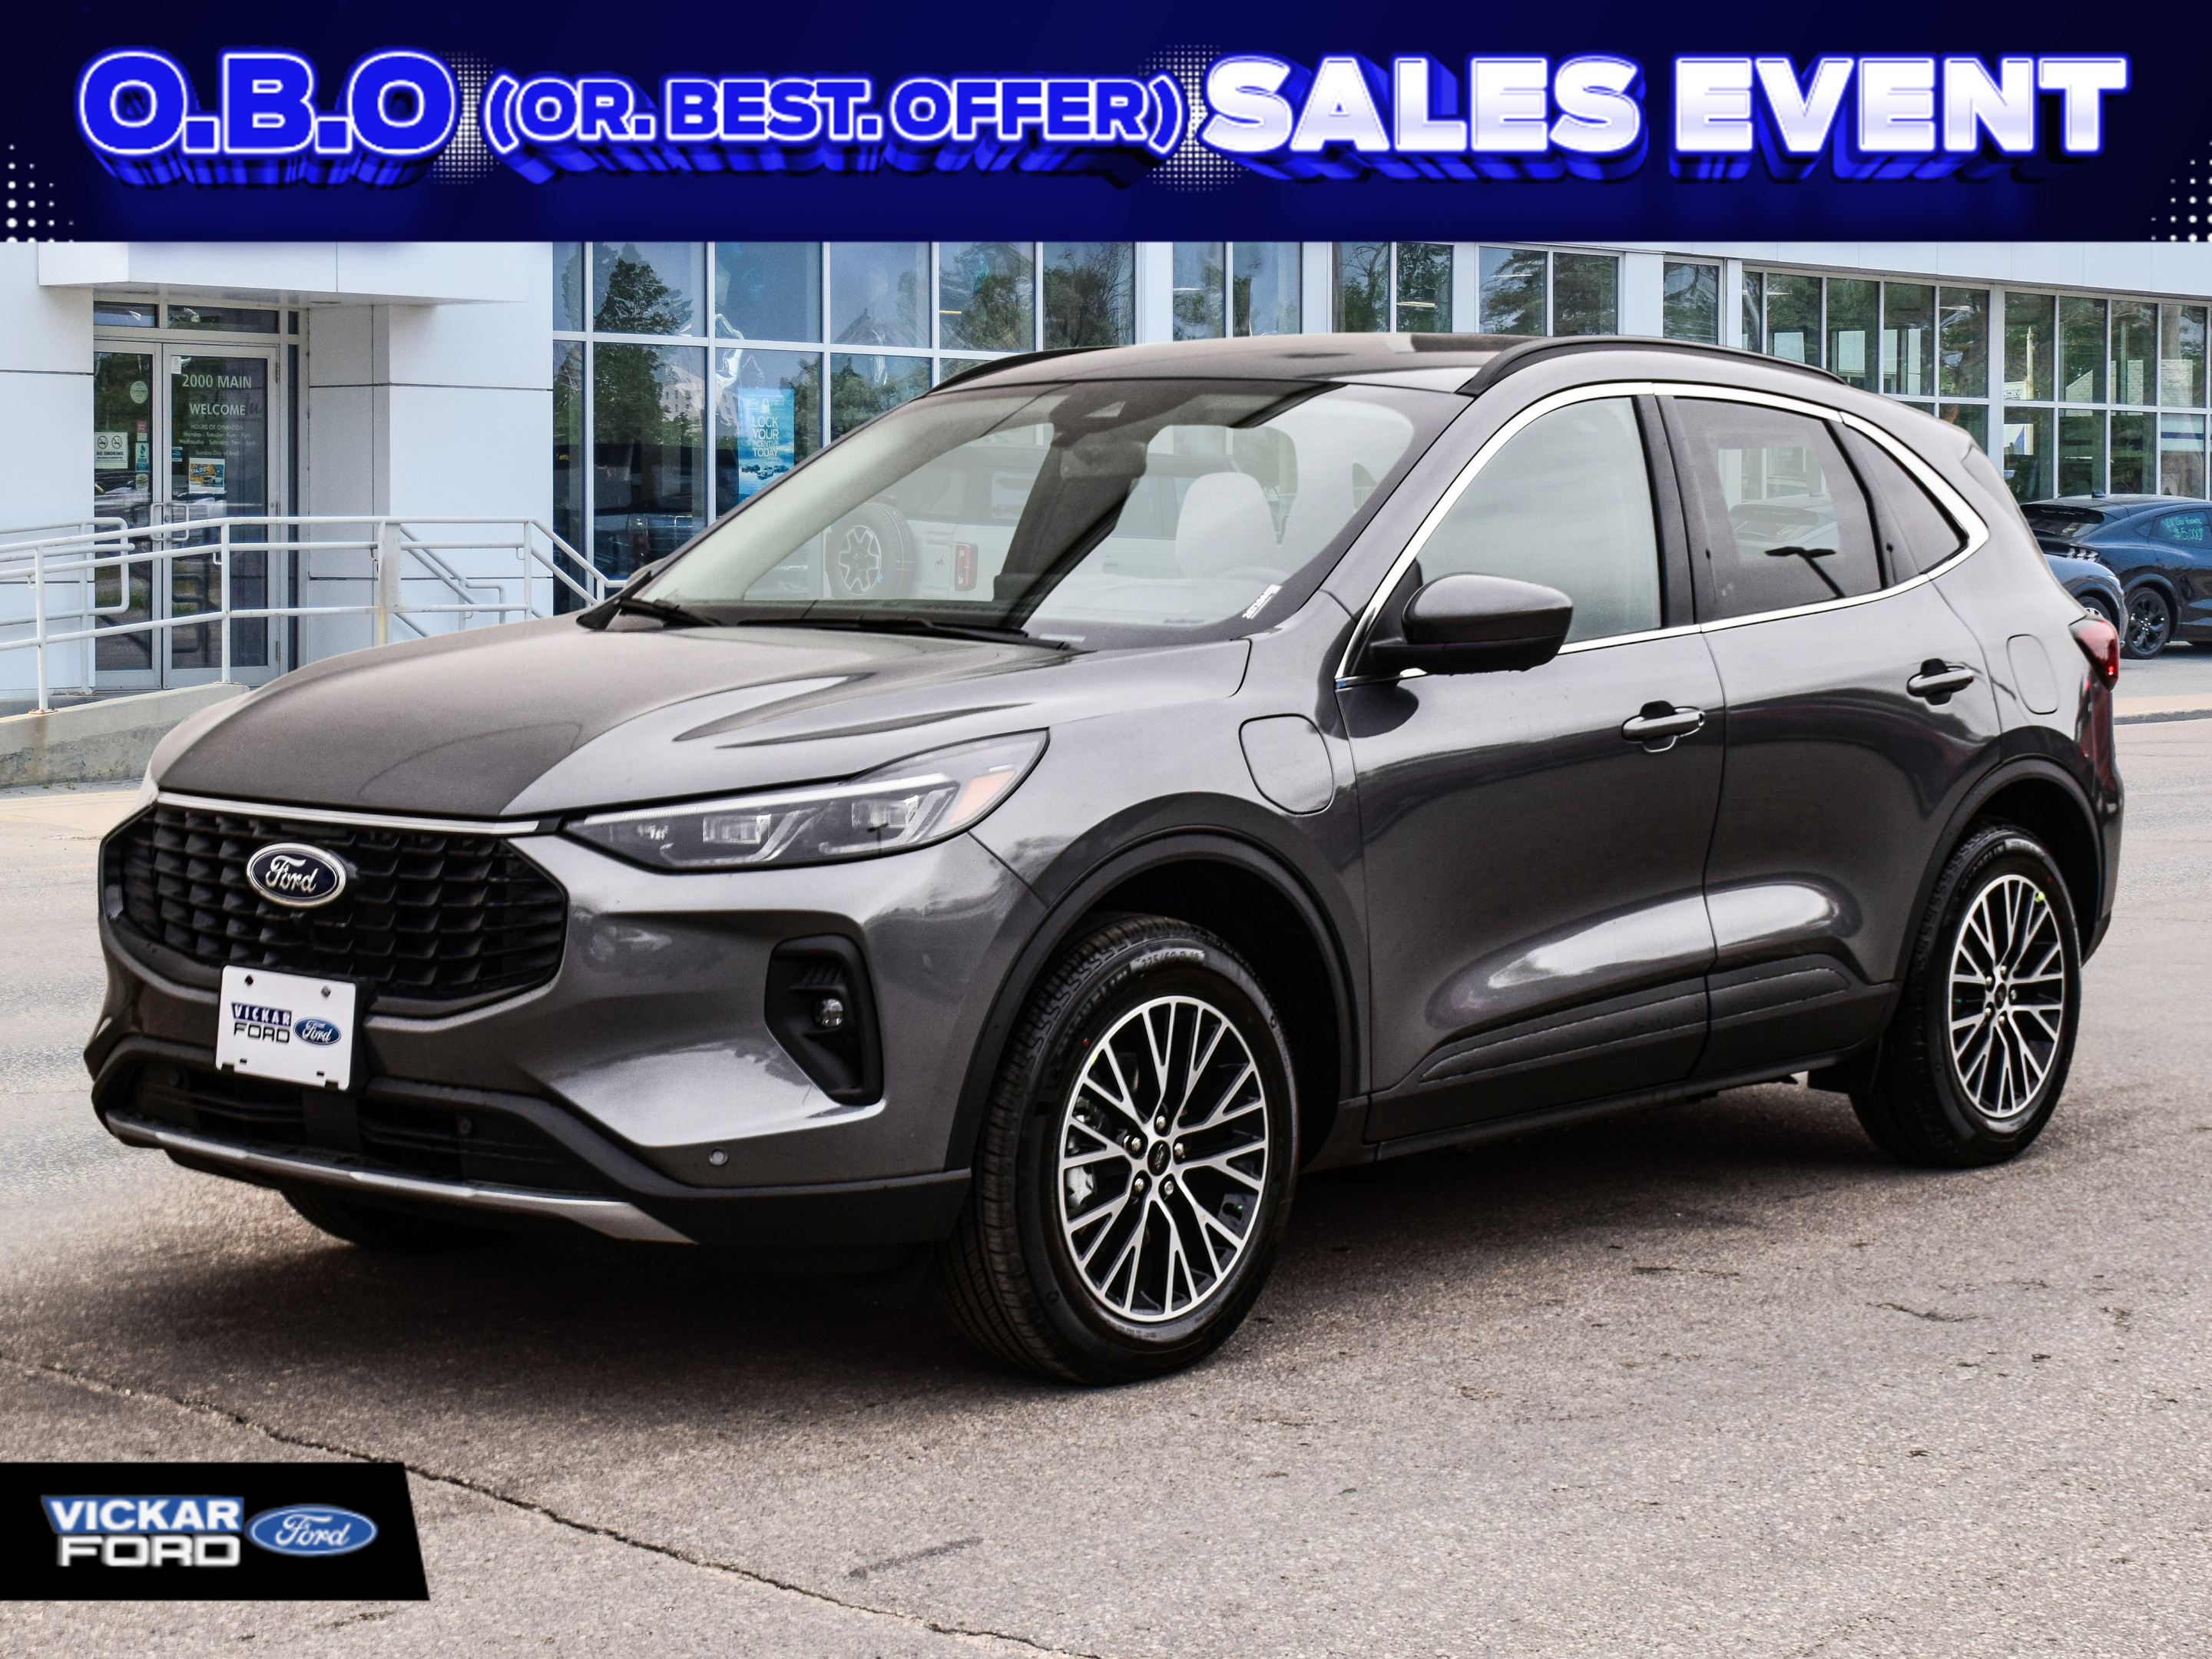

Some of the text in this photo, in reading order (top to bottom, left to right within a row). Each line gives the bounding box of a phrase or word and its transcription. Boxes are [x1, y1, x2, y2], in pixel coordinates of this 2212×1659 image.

[181, 374, 252, 389] 2000 MAIN
[189, 402, 246, 416] WELCOME
[753, 416, 779, 428] LOCK
[753, 428, 780, 440] YOUR
[753, 448, 779, 457] TODAY
[265, 855, 319, 893] Ford
[233, 1004, 291, 1026] VICKAR
[233, 1022, 290, 1044] FORD
[301, 1020, 329, 1042] Ford
